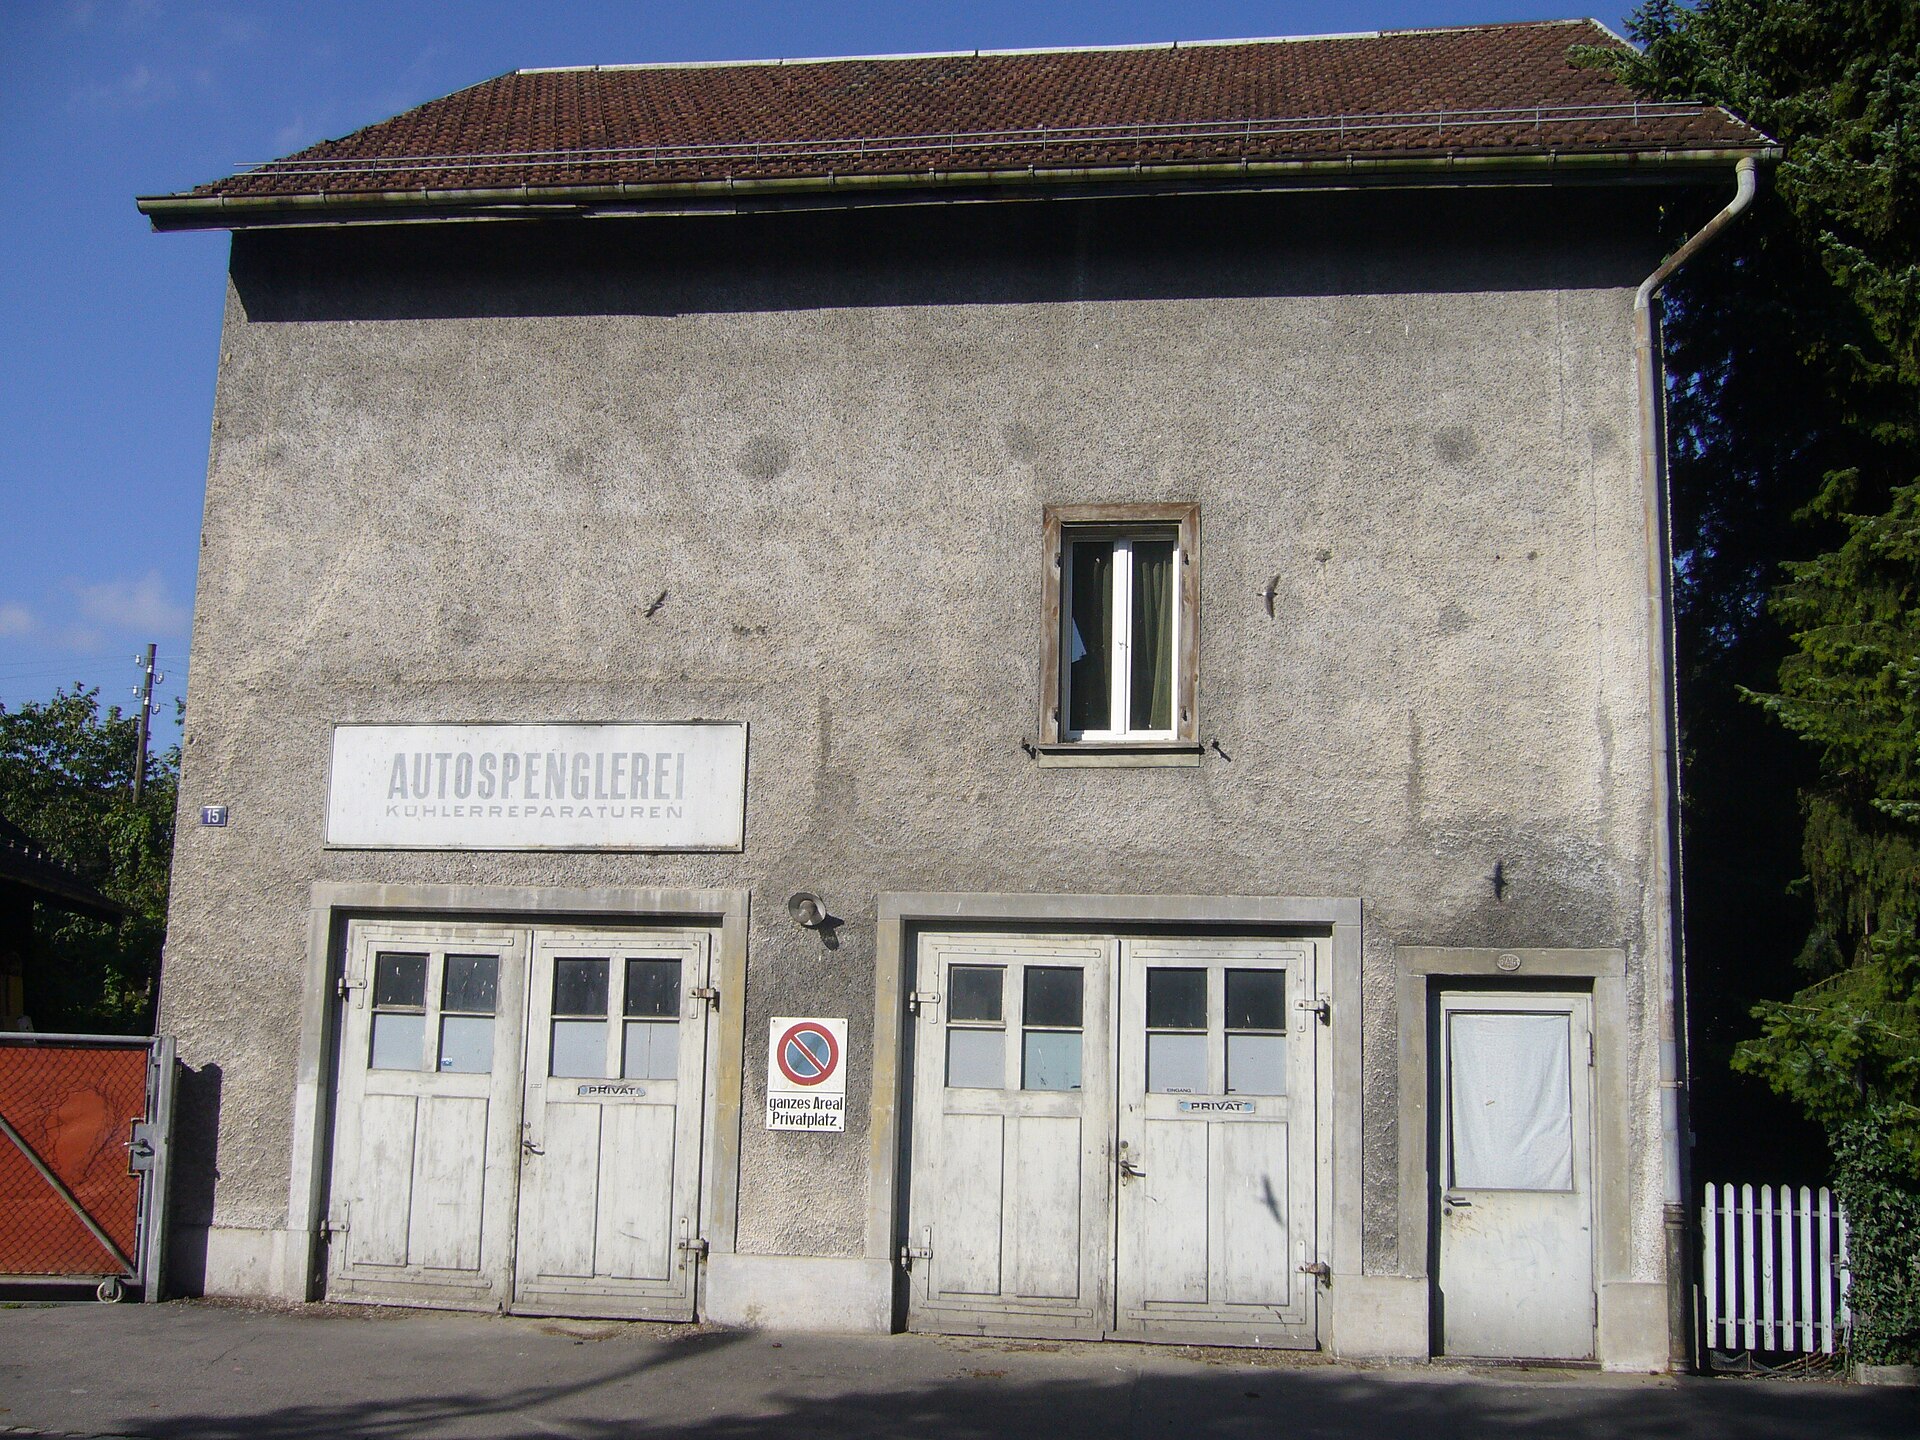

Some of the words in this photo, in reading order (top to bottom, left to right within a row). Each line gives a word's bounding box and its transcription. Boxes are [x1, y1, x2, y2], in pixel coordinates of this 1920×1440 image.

[387, 751, 685, 800] AUTOSPENGLEREI
[207, 809, 219, 823] 15
[588, 1086, 635, 1095] PRIVAT
[769, 1098, 811, 1111] ganzes
[813, 1096, 843, 1110] Areal
[1191, 1102, 1242, 1111] PRIVAT
[772, 1111, 837, 1128] Privatplatz
